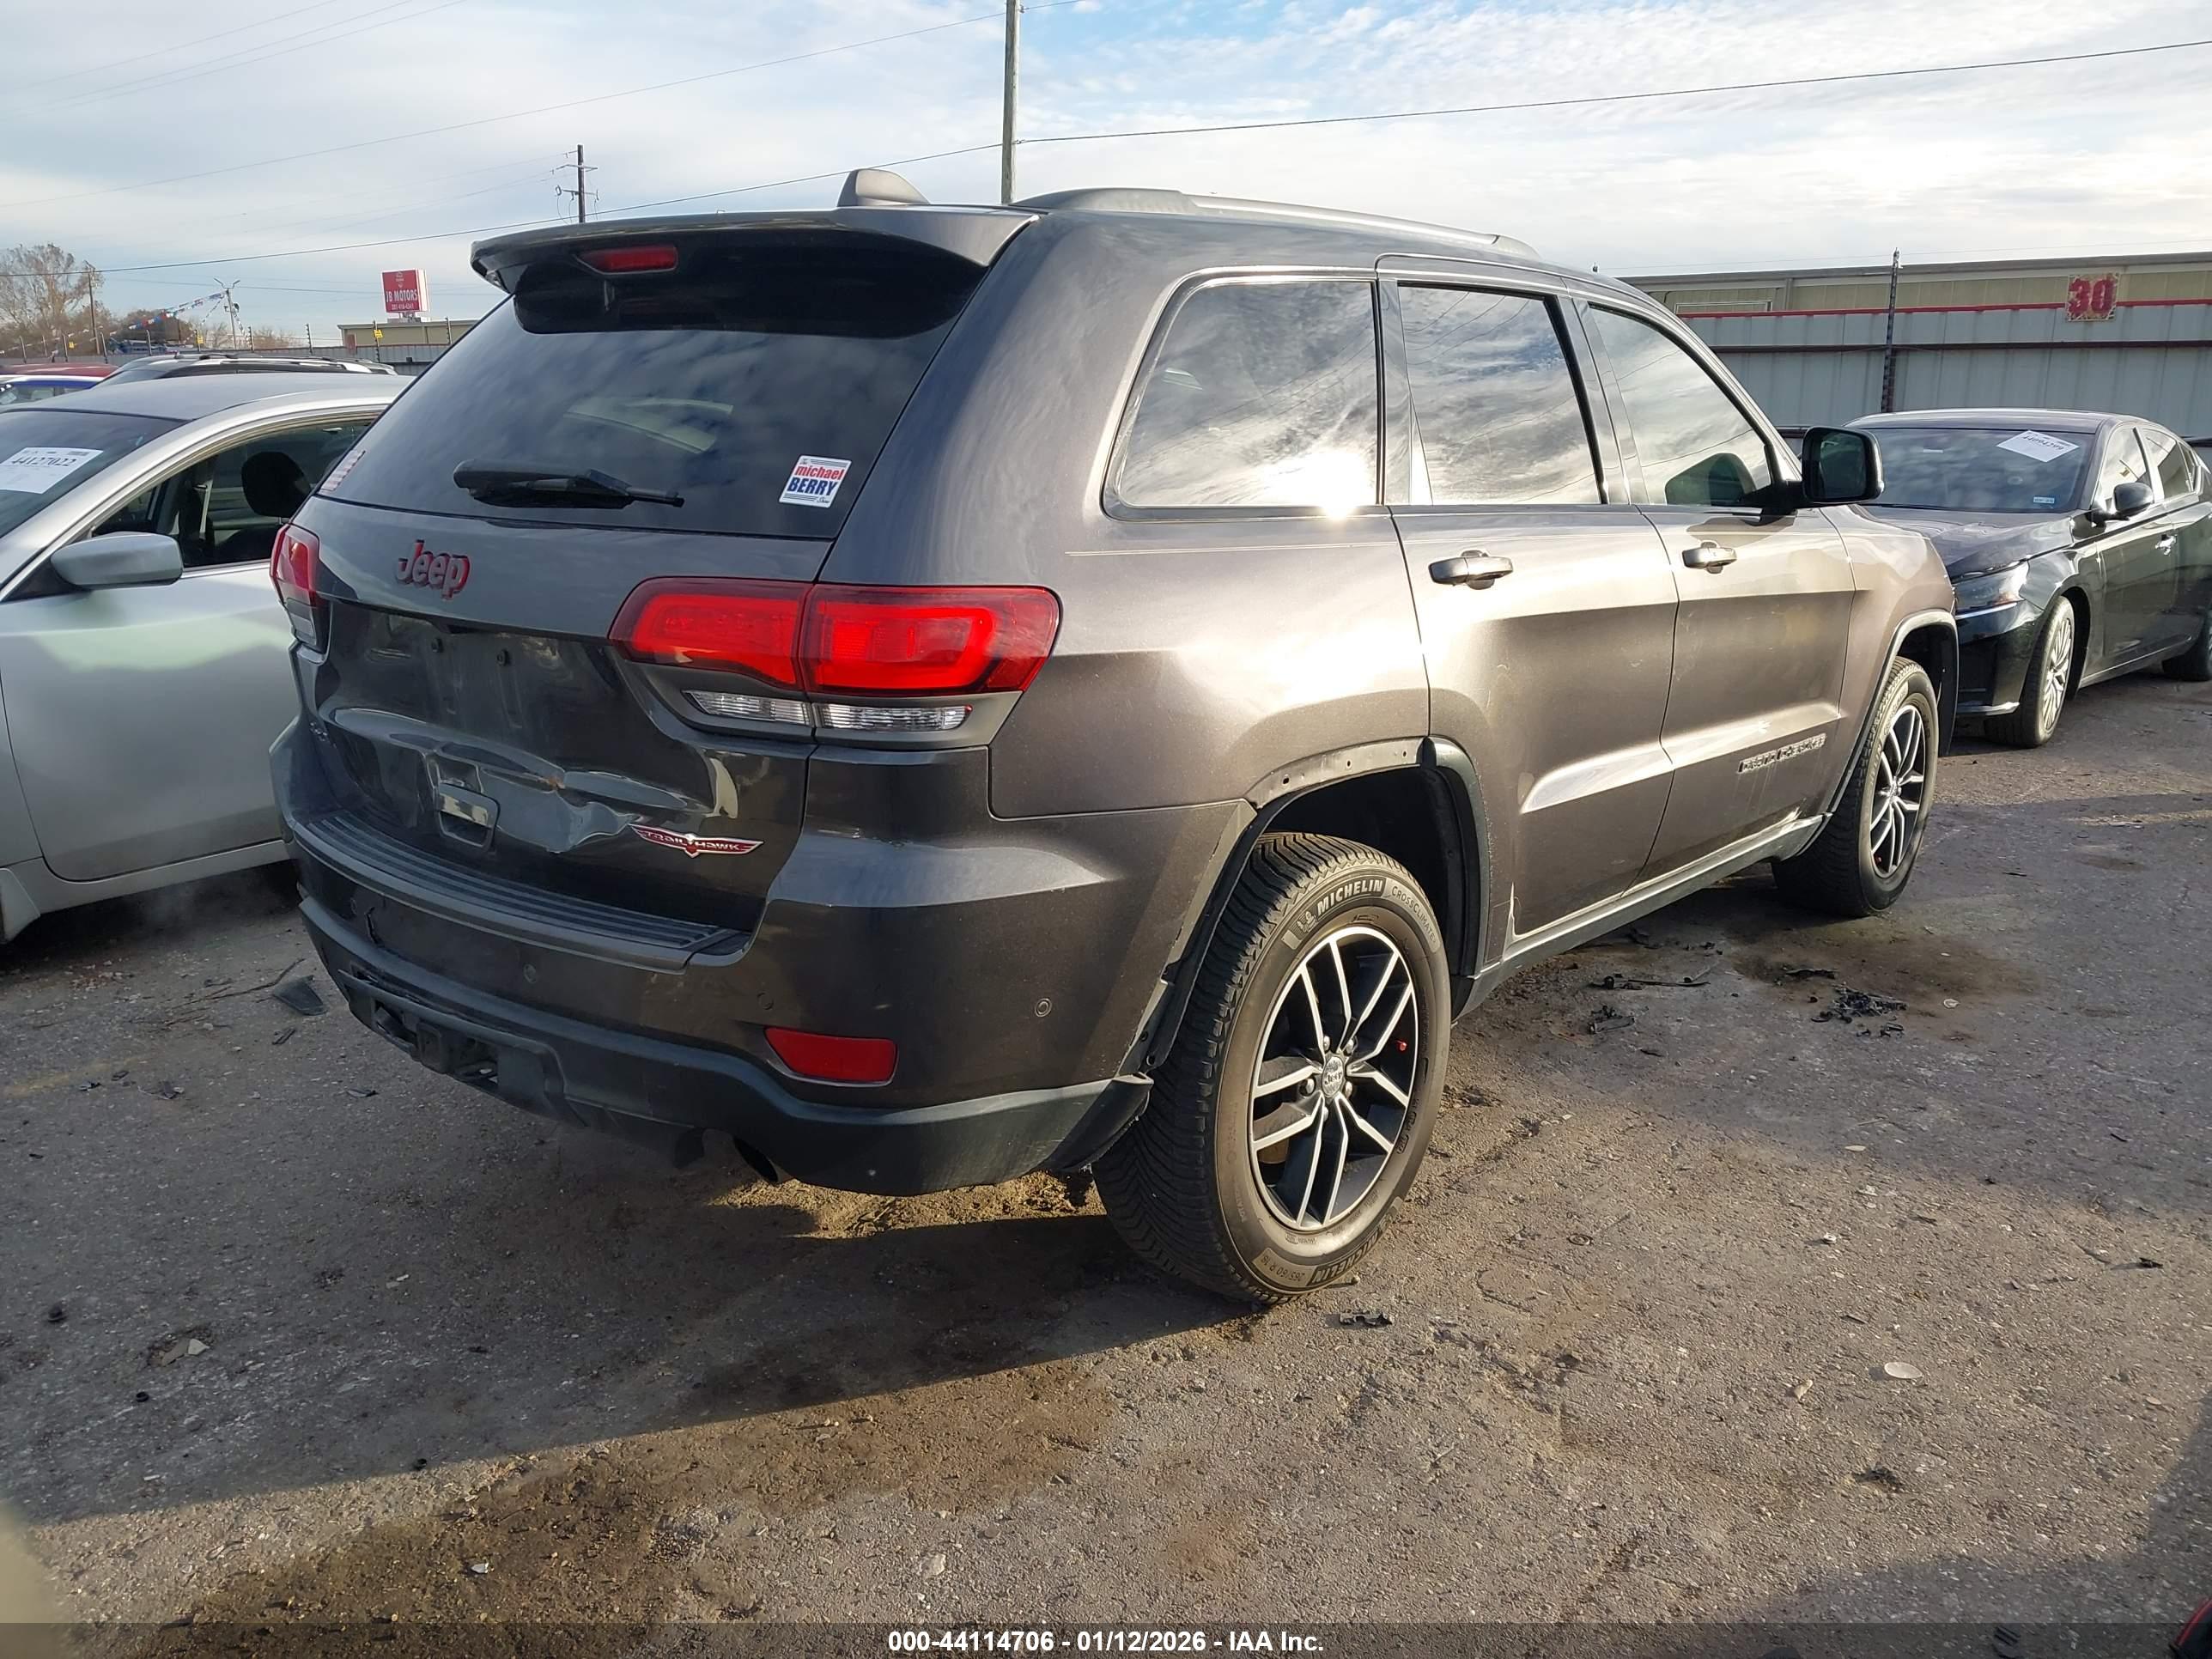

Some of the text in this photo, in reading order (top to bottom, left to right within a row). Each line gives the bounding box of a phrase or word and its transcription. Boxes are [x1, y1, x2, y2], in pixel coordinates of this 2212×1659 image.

[394, 289, 417, 301] MOTORS
[2069, 278, 2114, 317] 30
[787, 477, 838, 495] BERRY
[794, 465, 845, 480] michael
[398, 539, 470, 599] Jeep
[1317, 879, 1383, 916] MICHELIN
